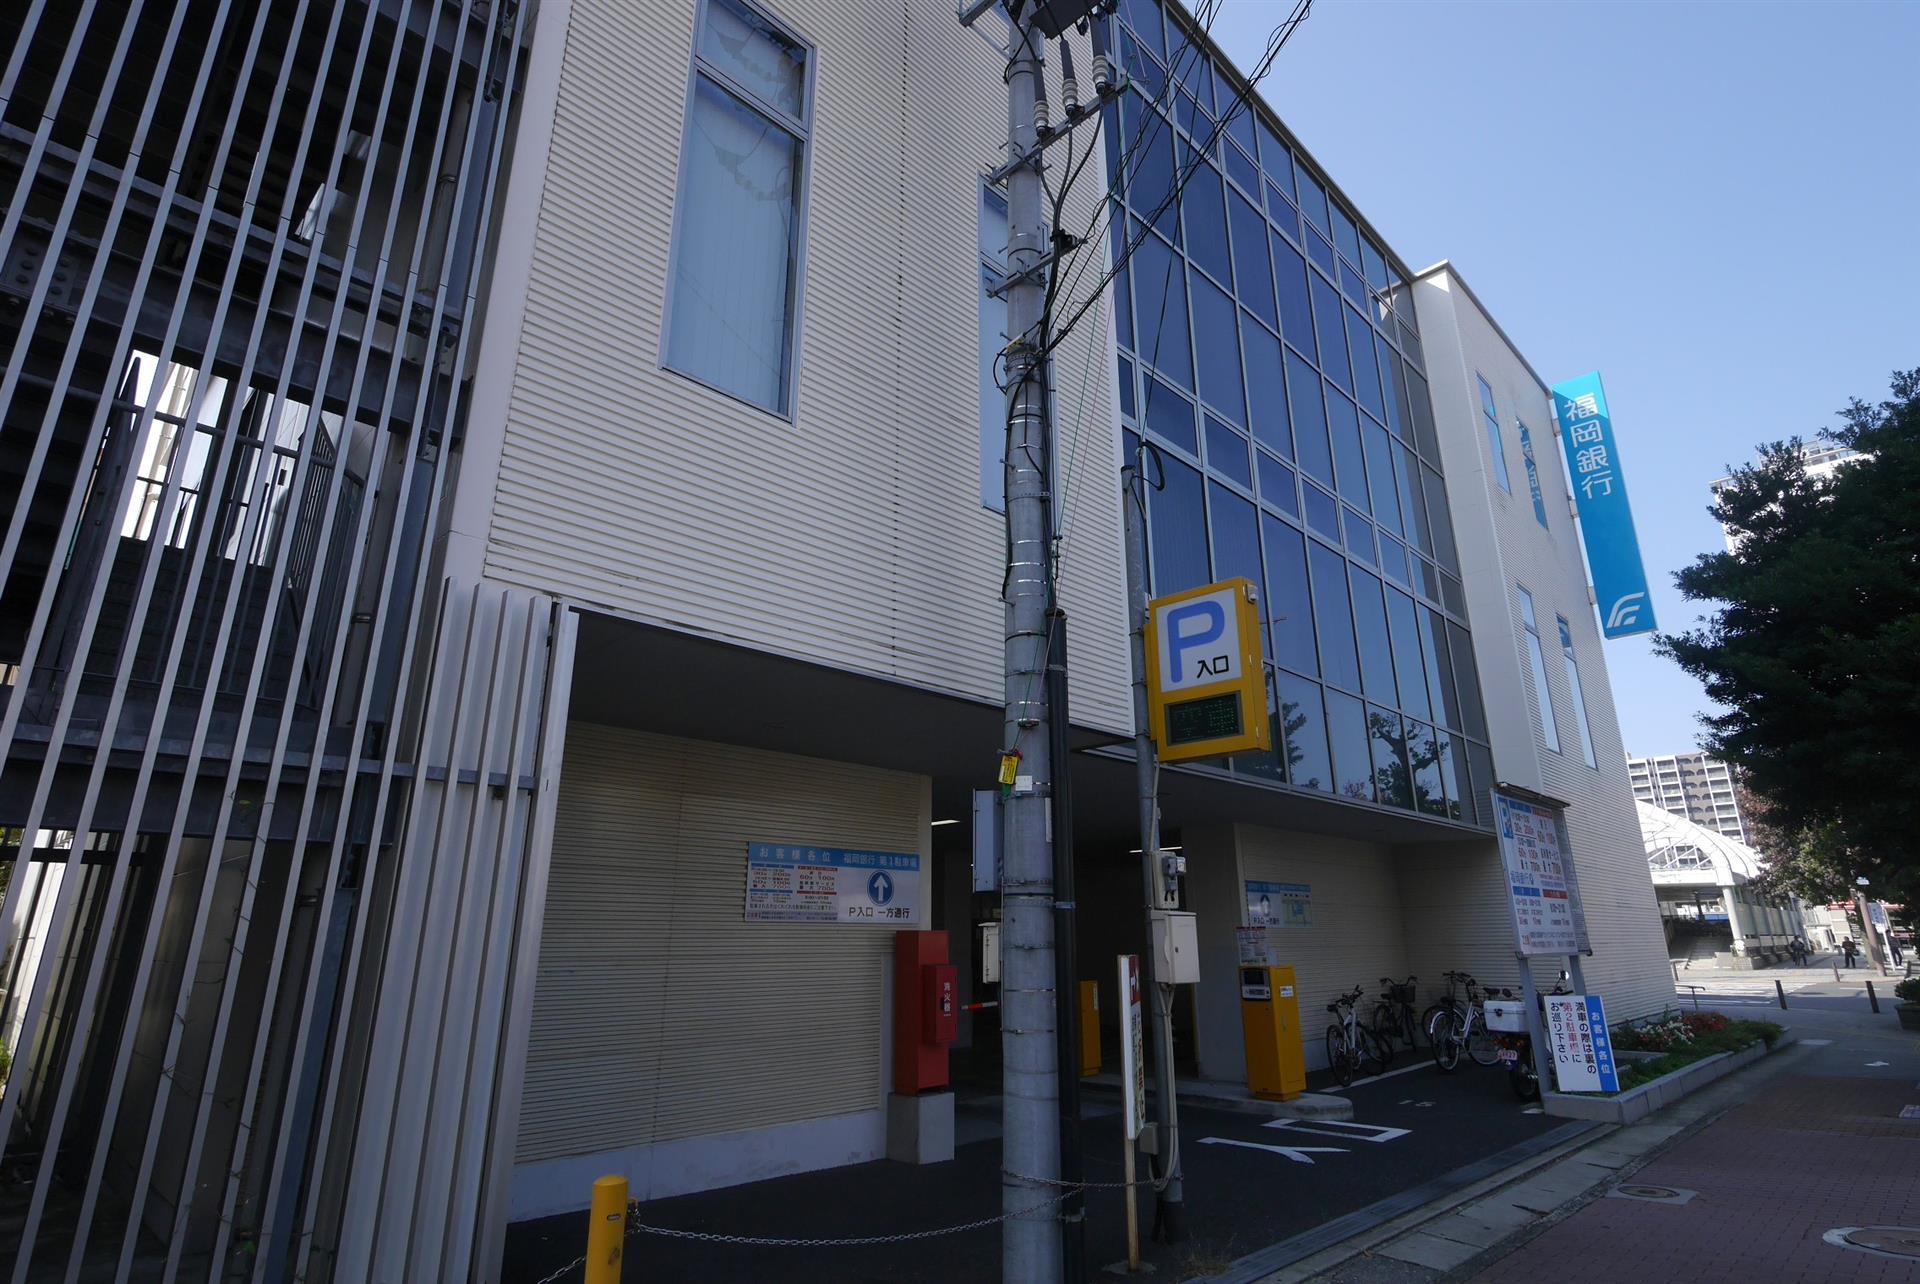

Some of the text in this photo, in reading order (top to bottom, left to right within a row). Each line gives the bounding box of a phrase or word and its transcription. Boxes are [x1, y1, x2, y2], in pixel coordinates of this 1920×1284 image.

[1564, 393, 1614, 499] 福岡銀行
[1167, 601, 1224, 683] P
[1196, 655, 1230, 679] 入口
[759, 847, 831, 862] お客様各位
[843, 854, 876, 866] 福岡銀行
[849, 906, 874, 918] P入口
[877, 907, 911, 920] 一方通行
[1575, 1002, 1596, 1074] 満車の際は裏の
[1592, 1012, 1611, 1074] お客様各位
